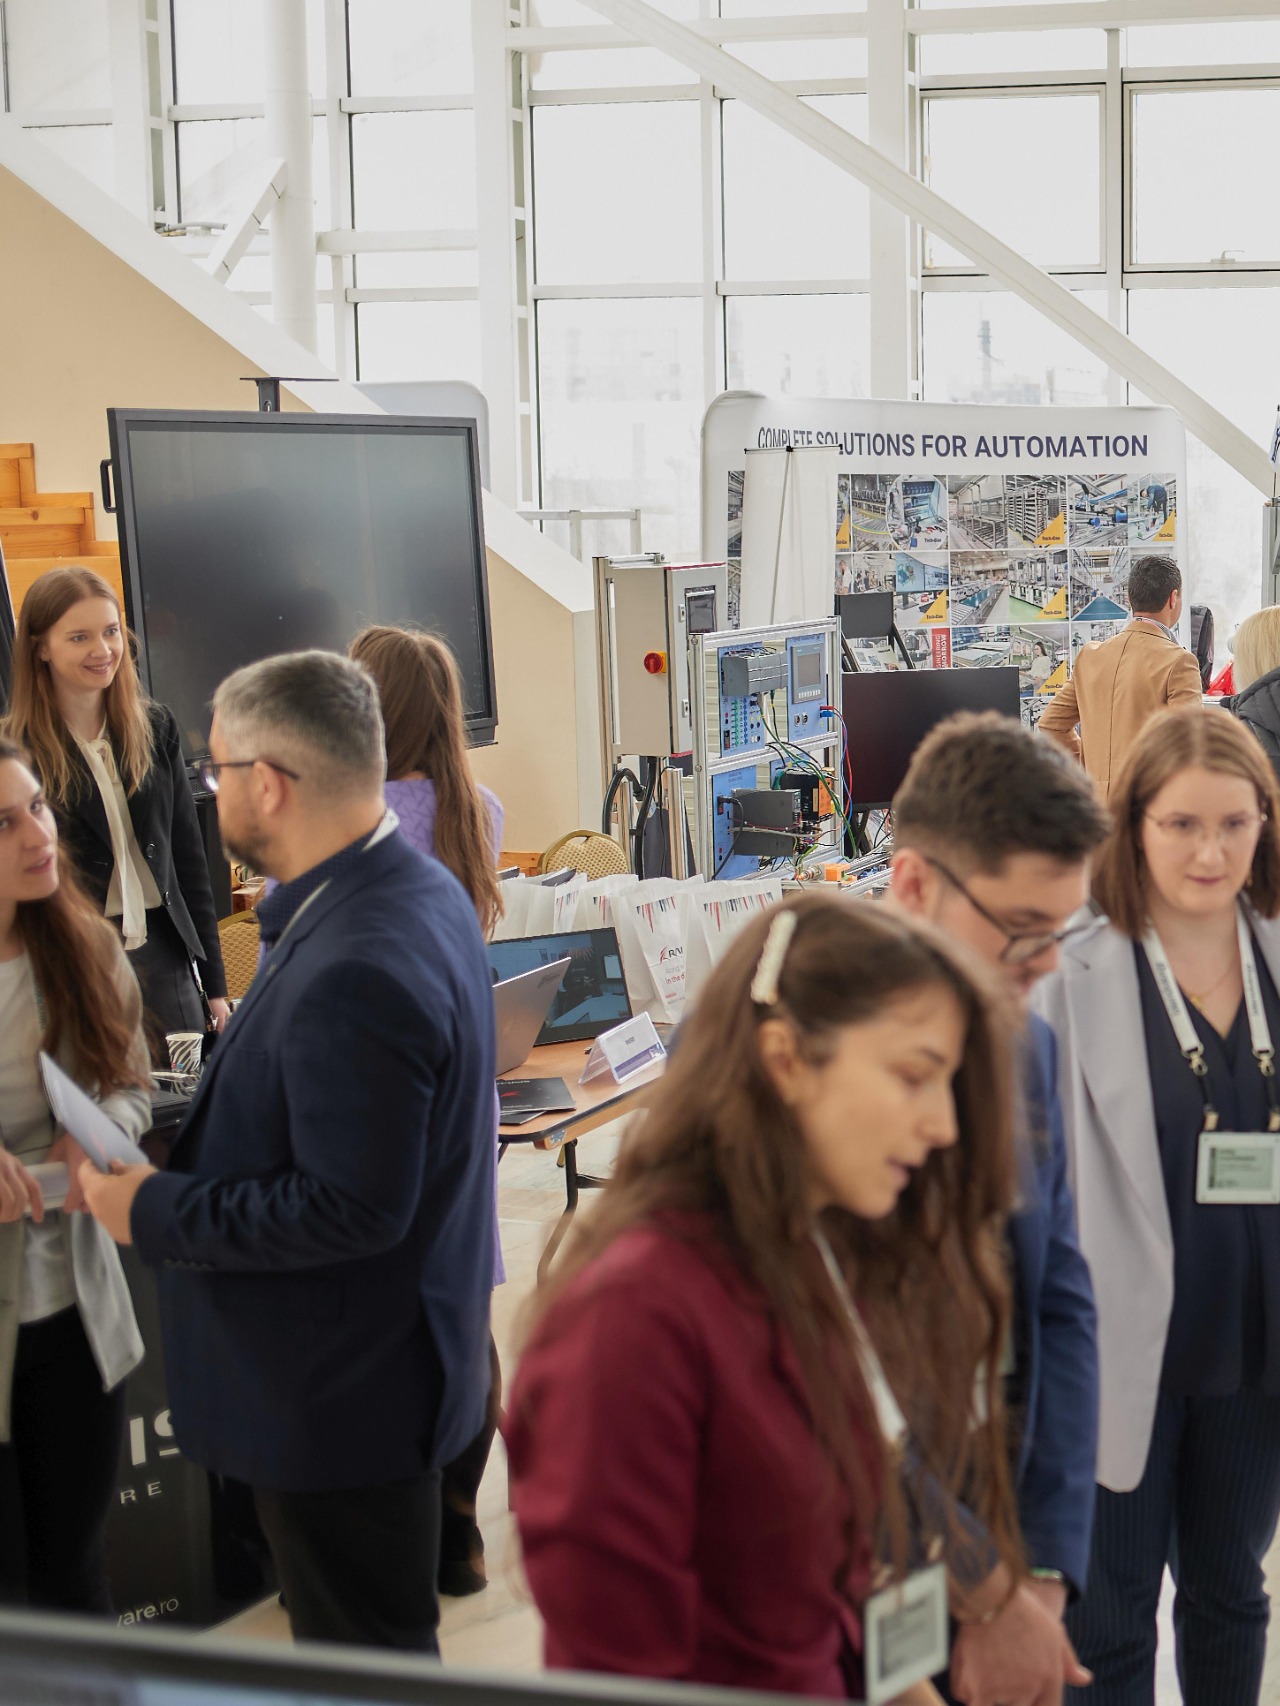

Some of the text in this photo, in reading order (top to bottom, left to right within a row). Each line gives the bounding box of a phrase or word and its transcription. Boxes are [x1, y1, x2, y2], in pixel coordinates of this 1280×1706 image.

[816, 430, 915, 457] SOLUTIONS
[922, 434, 967, 457] FOR
[974, 434, 1148, 458] AUTOMATION
